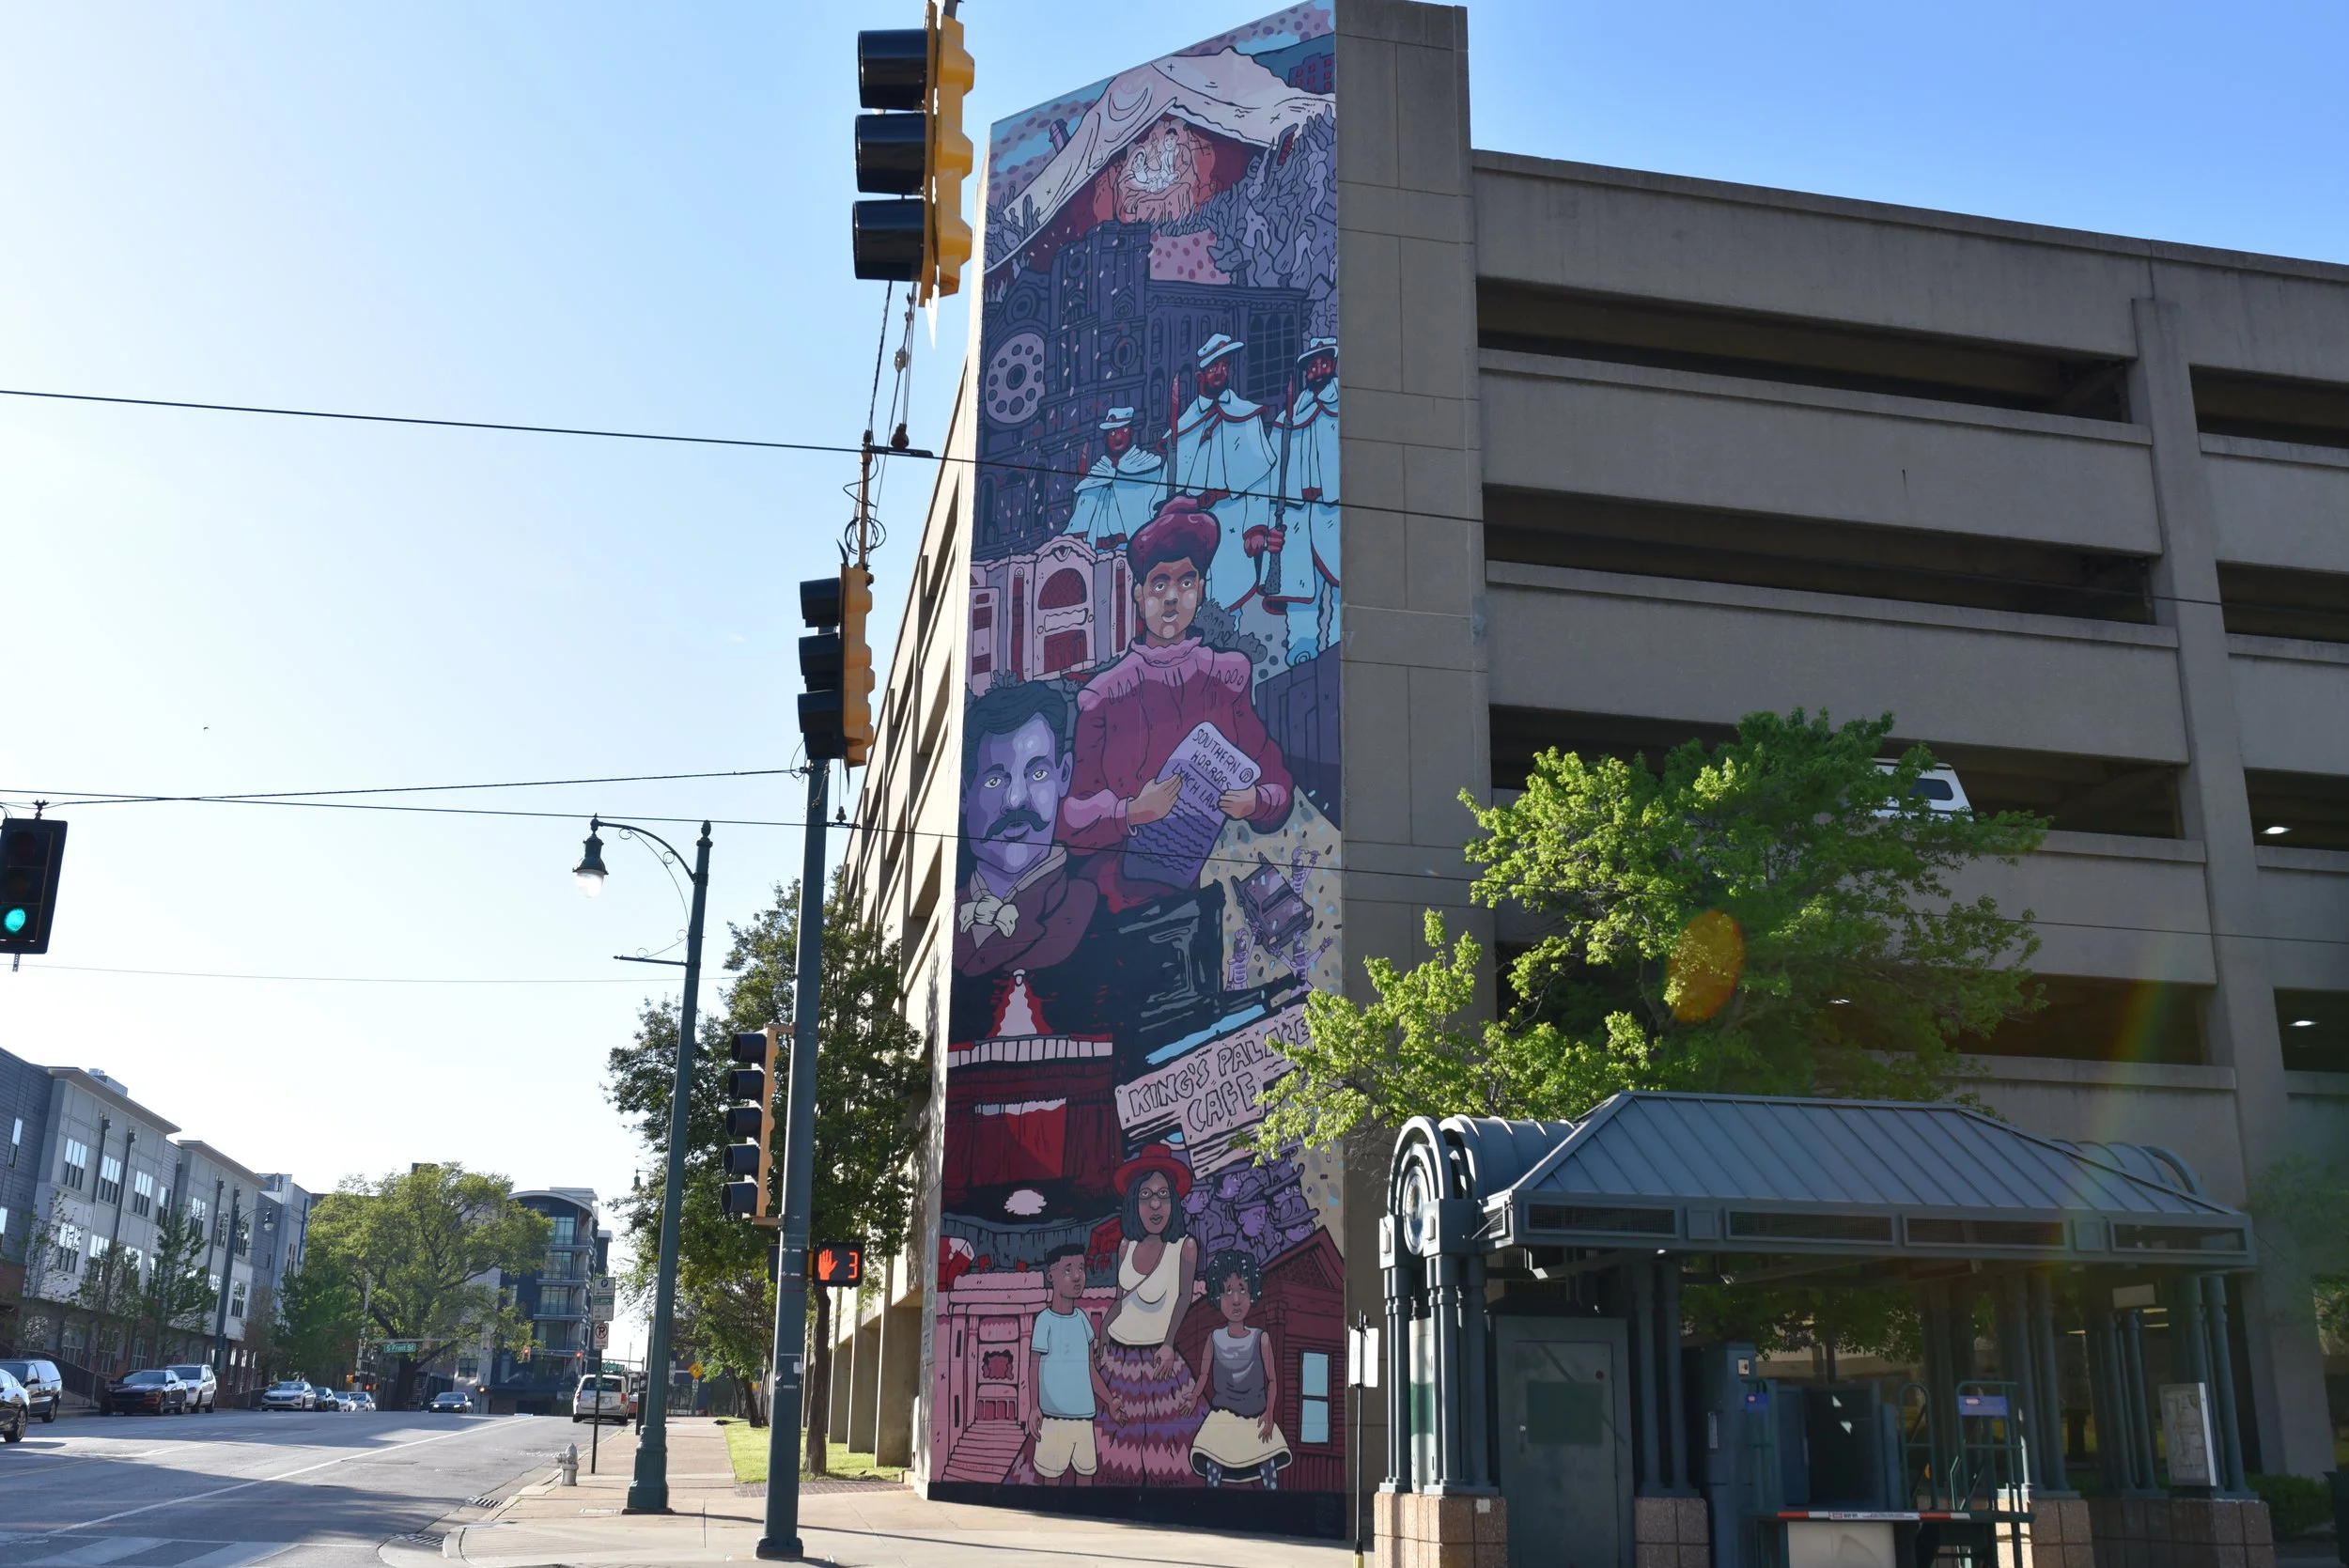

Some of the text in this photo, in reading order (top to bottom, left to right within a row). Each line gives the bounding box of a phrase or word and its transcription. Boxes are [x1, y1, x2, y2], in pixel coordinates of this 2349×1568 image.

[1190, 751, 1232, 790] HORRORS
[1192, 728, 1241, 773] SOUTHERN
[1172, 763, 1219, 812] LYNCH LAW
[1128, 1059, 1210, 1117] KING'S
[1187, 1072, 1257, 1132] CAFE
[848, 1251, 858, 1279] 3
